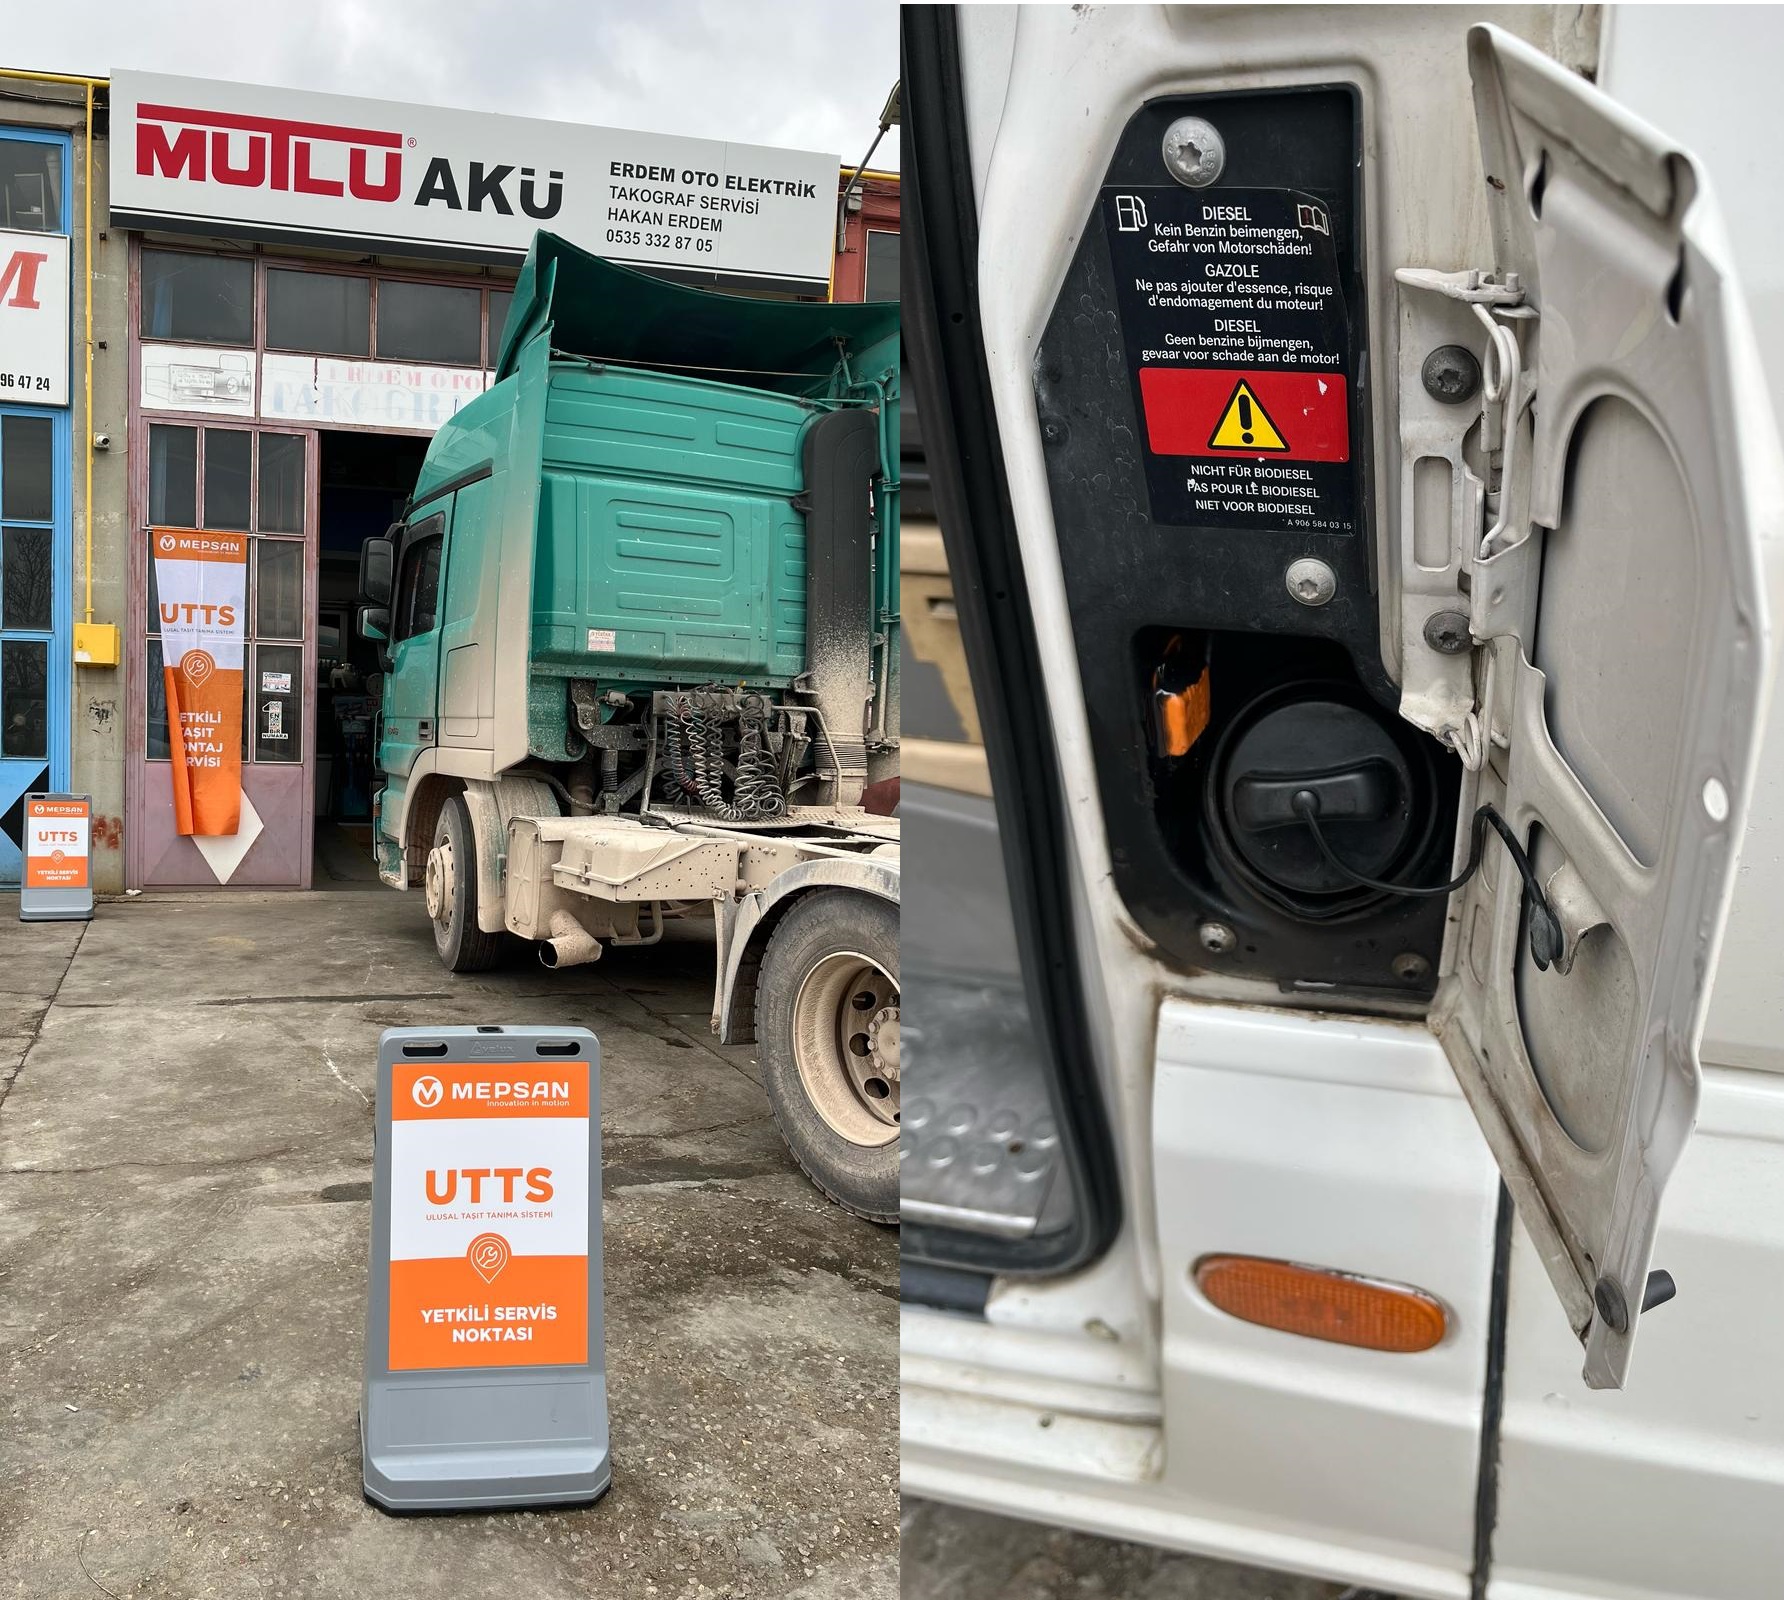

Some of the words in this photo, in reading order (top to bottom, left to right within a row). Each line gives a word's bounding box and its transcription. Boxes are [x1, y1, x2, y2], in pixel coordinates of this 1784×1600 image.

[136, 103, 403, 203] MUTLU
[414, 157, 563, 219] AKÜ
[609, 161, 675, 182] ERDEM
[681, 169, 719, 187] OTO
[725, 175, 816, 198] ELEKTRİK
[609, 185, 696, 208] TAKOGRAF
[699, 196, 760, 215] SERVİSİ
[607, 207, 663, 226] HAKAN
[668, 213, 723, 232] ERDEM
[1202, 206, 1252, 221] DIESEL
[1154, 223, 1182, 237] Kein
[1185, 224, 1226, 238] Benzin
[1229, 224, 1303, 241] beimengen,
[606, 229, 641, 245] 0535
[645, 233, 670, 248] 332
[675, 236, 692, 250] 87
[696, 238, 713, 253] 05
[1148, 239, 1190, 253] Gefahr
[1192, 243, 1215, 253] von
[1218, 241, 1313, 256] Motorschäden!
[1205, 263, 1260, 278] GAZOLE
[1135, 279, 1154, 291] Ne
[1156, 282, 1178, 294] pas
[1180, 280, 1223, 295] ajouter
[1226, 281, 1292, 296] d'essence,
[1294, 282, 1333, 298] risque
[1148, 295, 1254, 311] d'endomagement
[1256, 297, 1273, 309] du
[1275, 298, 1324, 311] moteur!
[1214, 319, 1261, 333] DIESEL
[1165, 333, 1196, 345] Geen
[1198, 335, 1245, 347] benzine
[1247, 335, 1314, 351] bijmengen,
[1142, 350, 1180, 362] gevaar
[1183, 351, 1210, 361] voor
[1212, 350, 1254, 362] schade
[1257, 353, 1279, 363] aan
[1282, 352, 1297, 363] de
[1300, 353, 1340, 365] motor!
[0, 373, 14, 387] 96
[18, 375, 31, 389] 47
[36, 376, 50, 391] 24
[1191, 464, 1225, 477] NICHT
[1229, 464, 1251, 478] FÜR
[1254, 467, 1314, 481] BIODIESEL
[1187, 481, 1209, 493] PAS
[1211, 483, 1243, 495] POUR
[1262, 485, 1320, 499] BIODIESEL
[1195, 500, 1220, 511] NIET
[1222, 501, 1255, 513] VOOR
[1257, 503, 1316, 516] BIODIESEL
[1343, 522, 1352, 530] 15
[180, 540, 239, 551] MEPSAN
[160, 603, 236, 626] UTTS
[180, 711, 222, 723] ETKİLİ
[184, 742, 224, 753] NTAJ
[186, 755, 221, 768] RVİSİ
[38, 831, 78, 842] UTTS
[452, 1082, 569, 1099] MEPSAN
[425, 1168, 554, 1205] UTTS
[426, 1212, 458, 1220] ULUSAL
[461, 1212, 484, 1220] TAŞIT
[487, 1211, 519, 1219] TANIMA
[520, 1210, 553, 1218] SİSTEMİ
[421, 1304, 489, 1323] YETKİLİ
[494, 1303, 558, 1321] SERVİS
[452, 1327, 533, 1343] NOKTASI
